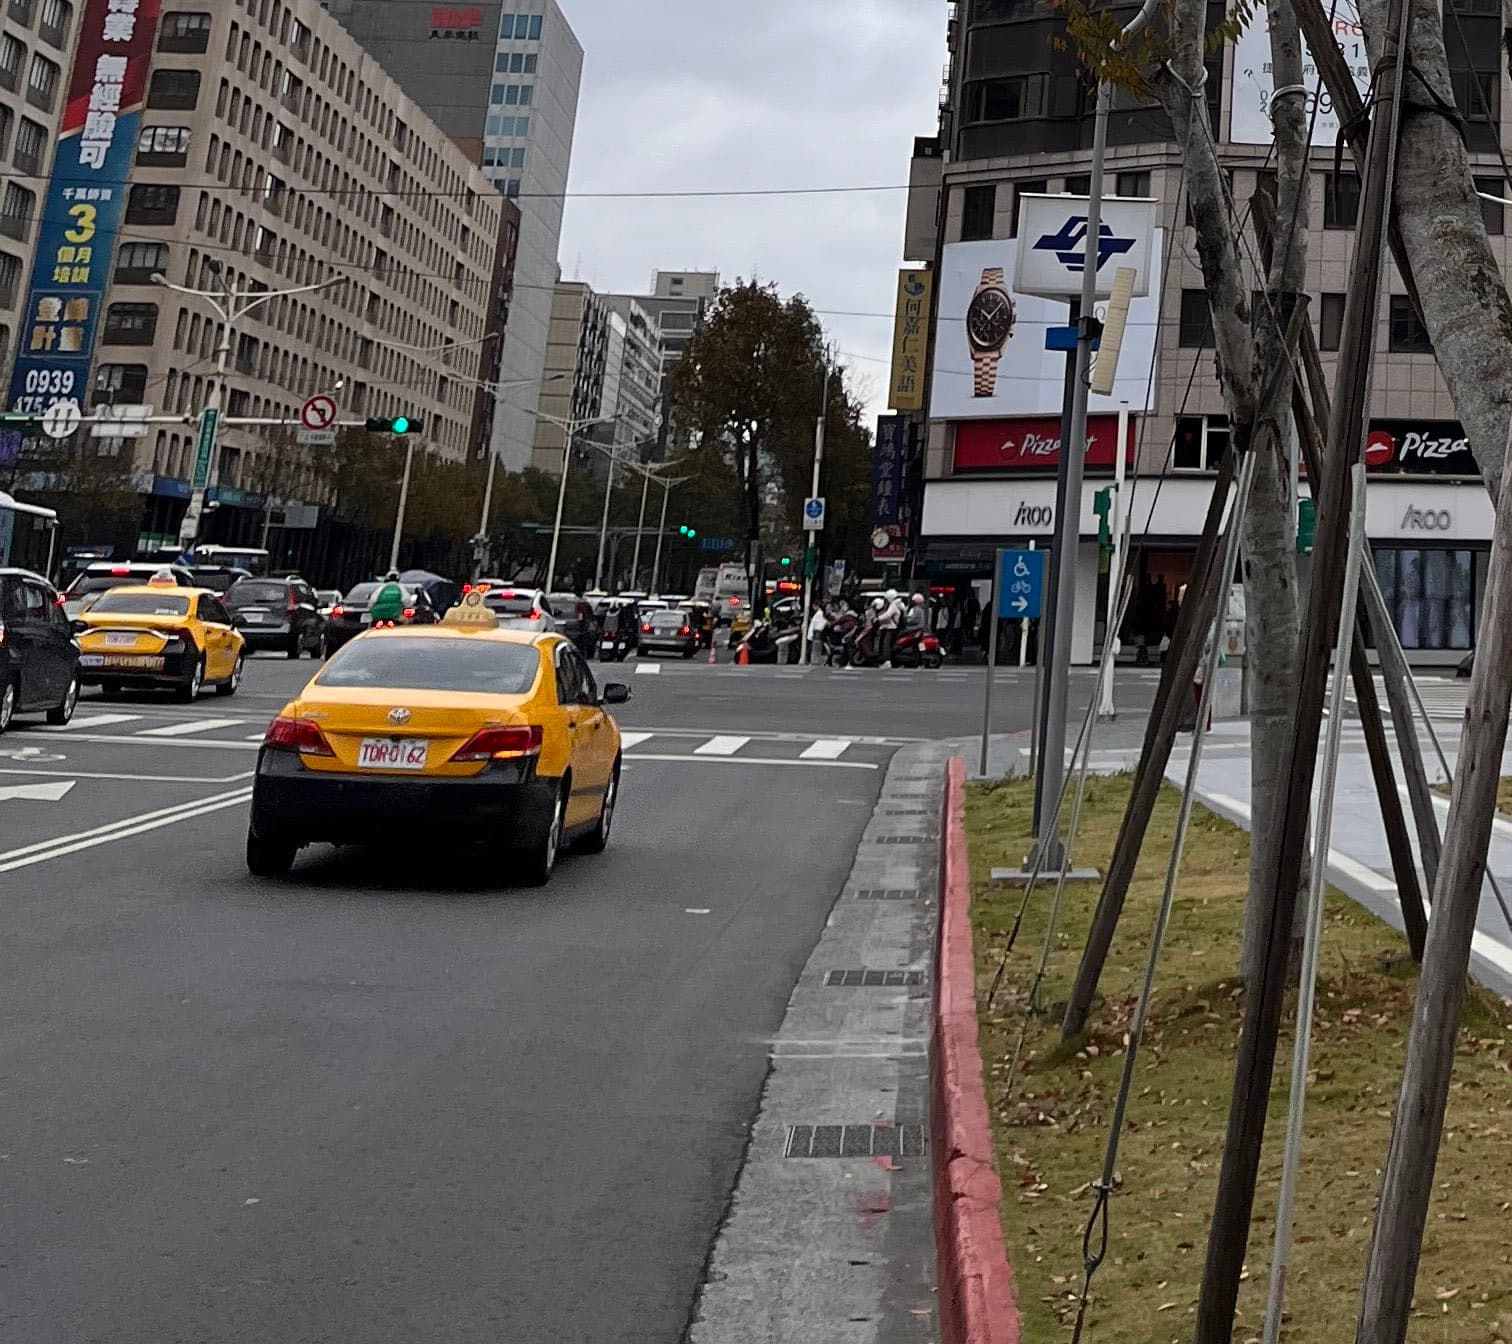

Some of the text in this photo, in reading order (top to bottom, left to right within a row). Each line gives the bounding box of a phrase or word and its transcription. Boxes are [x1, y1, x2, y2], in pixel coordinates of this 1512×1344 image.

[64, 203, 97, 244] 3
[25, 369, 75, 394] 0939
[1400, 432, 1469, 461] Pizza
